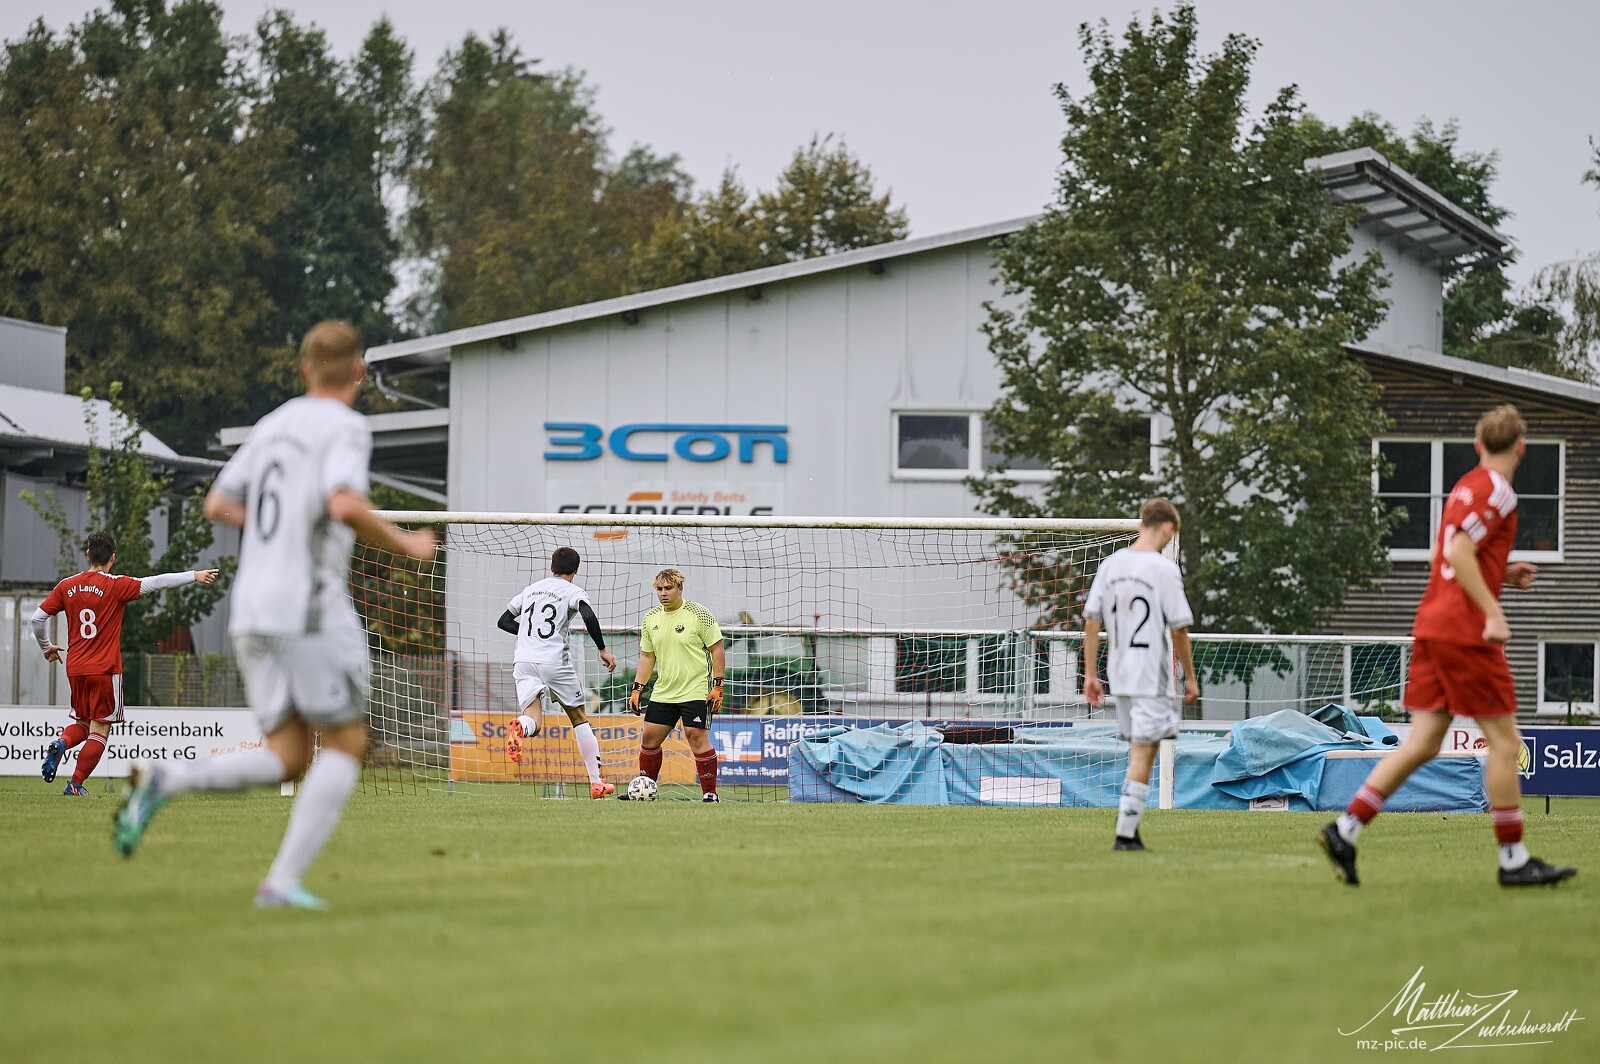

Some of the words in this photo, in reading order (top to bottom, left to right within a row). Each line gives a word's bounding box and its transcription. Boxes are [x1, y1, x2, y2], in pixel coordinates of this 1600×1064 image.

[543, 422, 788, 463] 3Con
[256, 460, 285, 544] 6
[670, 490, 710, 504] Safety
[714, 491, 746, 503] Belts
[67, 586, 77, 598] SV
[79, 584, 104, 597] Laufen
[79, 608, 97, 640] 8
[524, 601, 557, 639] 13
[1111, 595, 1150, 649] 12
[108, 745, 166, 760] Südost
[173, 746, 197, 761] eG
